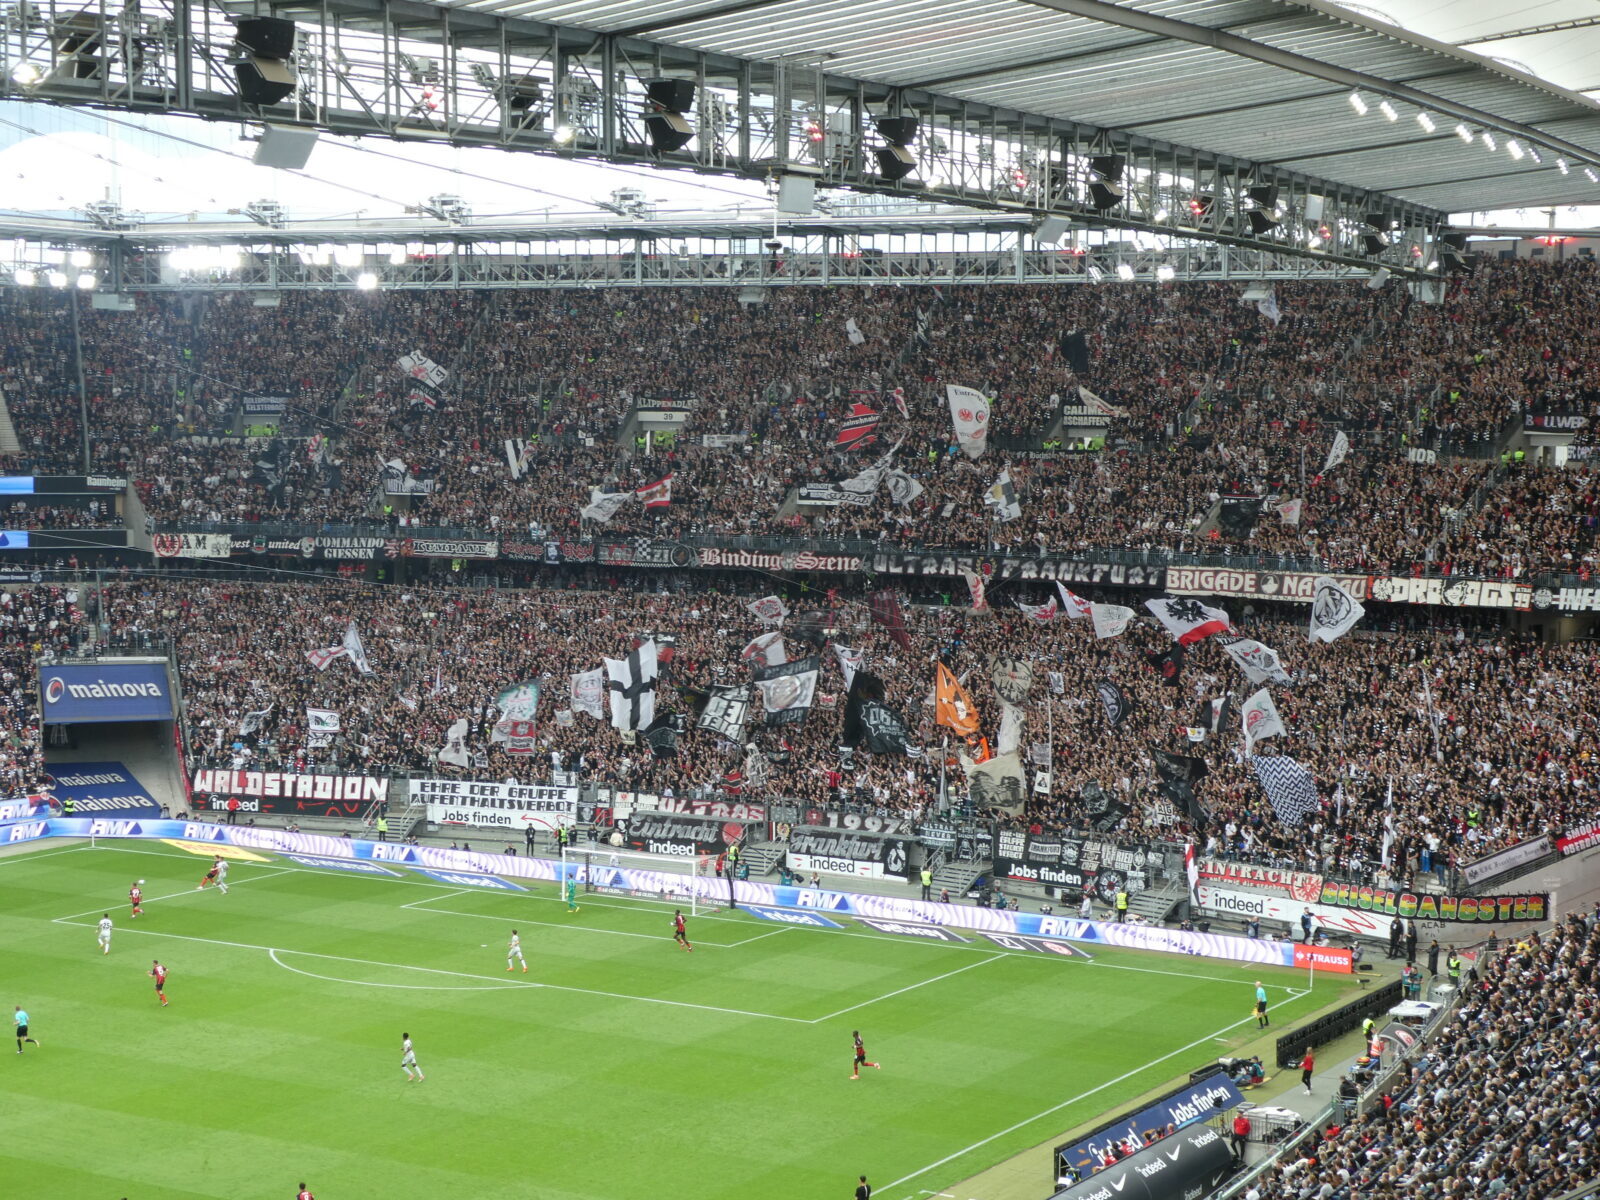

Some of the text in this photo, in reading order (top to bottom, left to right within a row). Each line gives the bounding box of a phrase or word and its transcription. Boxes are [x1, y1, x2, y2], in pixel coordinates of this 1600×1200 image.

[664, 413, 673, 421] 39
[268, 540, 300, 550] united
[315, 537, 384, 548] COMMANDO
[413, 542, 486, 555] KUMPANE
[324, 548, 374, 559] GIESSEN
[700, 548, 861, 571] Binding Szene
[873, 555, 1165, 584] ULTRAS FRANKFURT
[1166, 570, 1256, 593] BRIGADE
[67, 677, 162, 700] mainova
[58, 770, 125, 787] mainova
[195, 769, 388, 802] WALDSTADION
[420, 782, 567, 800] EHRE DER GRUPPE
[72, 791, 153, 813] mainova
[411, 793, 576, 812] AUFENTHALTSVERBOT
[442, 810, 512, 824] Jobs finden
[827, 812, 901, 834] 1997
[10, 821, 45, 842] RMV
[90, 821, 135, 836] RMV
[184, 823, 218, 840] RMV
[629, 816, 719, 843] Eintracht
[372, 844, 409, 862] RMV
[649, 840, 695, 856] indeed
[810, 856, 855, 873] indeed
[1008, 863, 1082, 885] Jobs finden
[1197, 860, 1307, 887] EINTRACHT
[576, 866, 618, 884] RMV
[796, 890, 844, 910] RMV
[1214, 893, 1263, 914] indeed
[1320, 882, 1544, 921] GEISELGANGSTER
[1039, 918, 1089, 939] RMV
[1306, 952, 1349, 966] STRAUSS
[1168, 1083, 1231, 1125] Jobs finden
[1191, 1129, 1217, 1149] indeed
[1138, 1158, 1168, 1180] indeed
